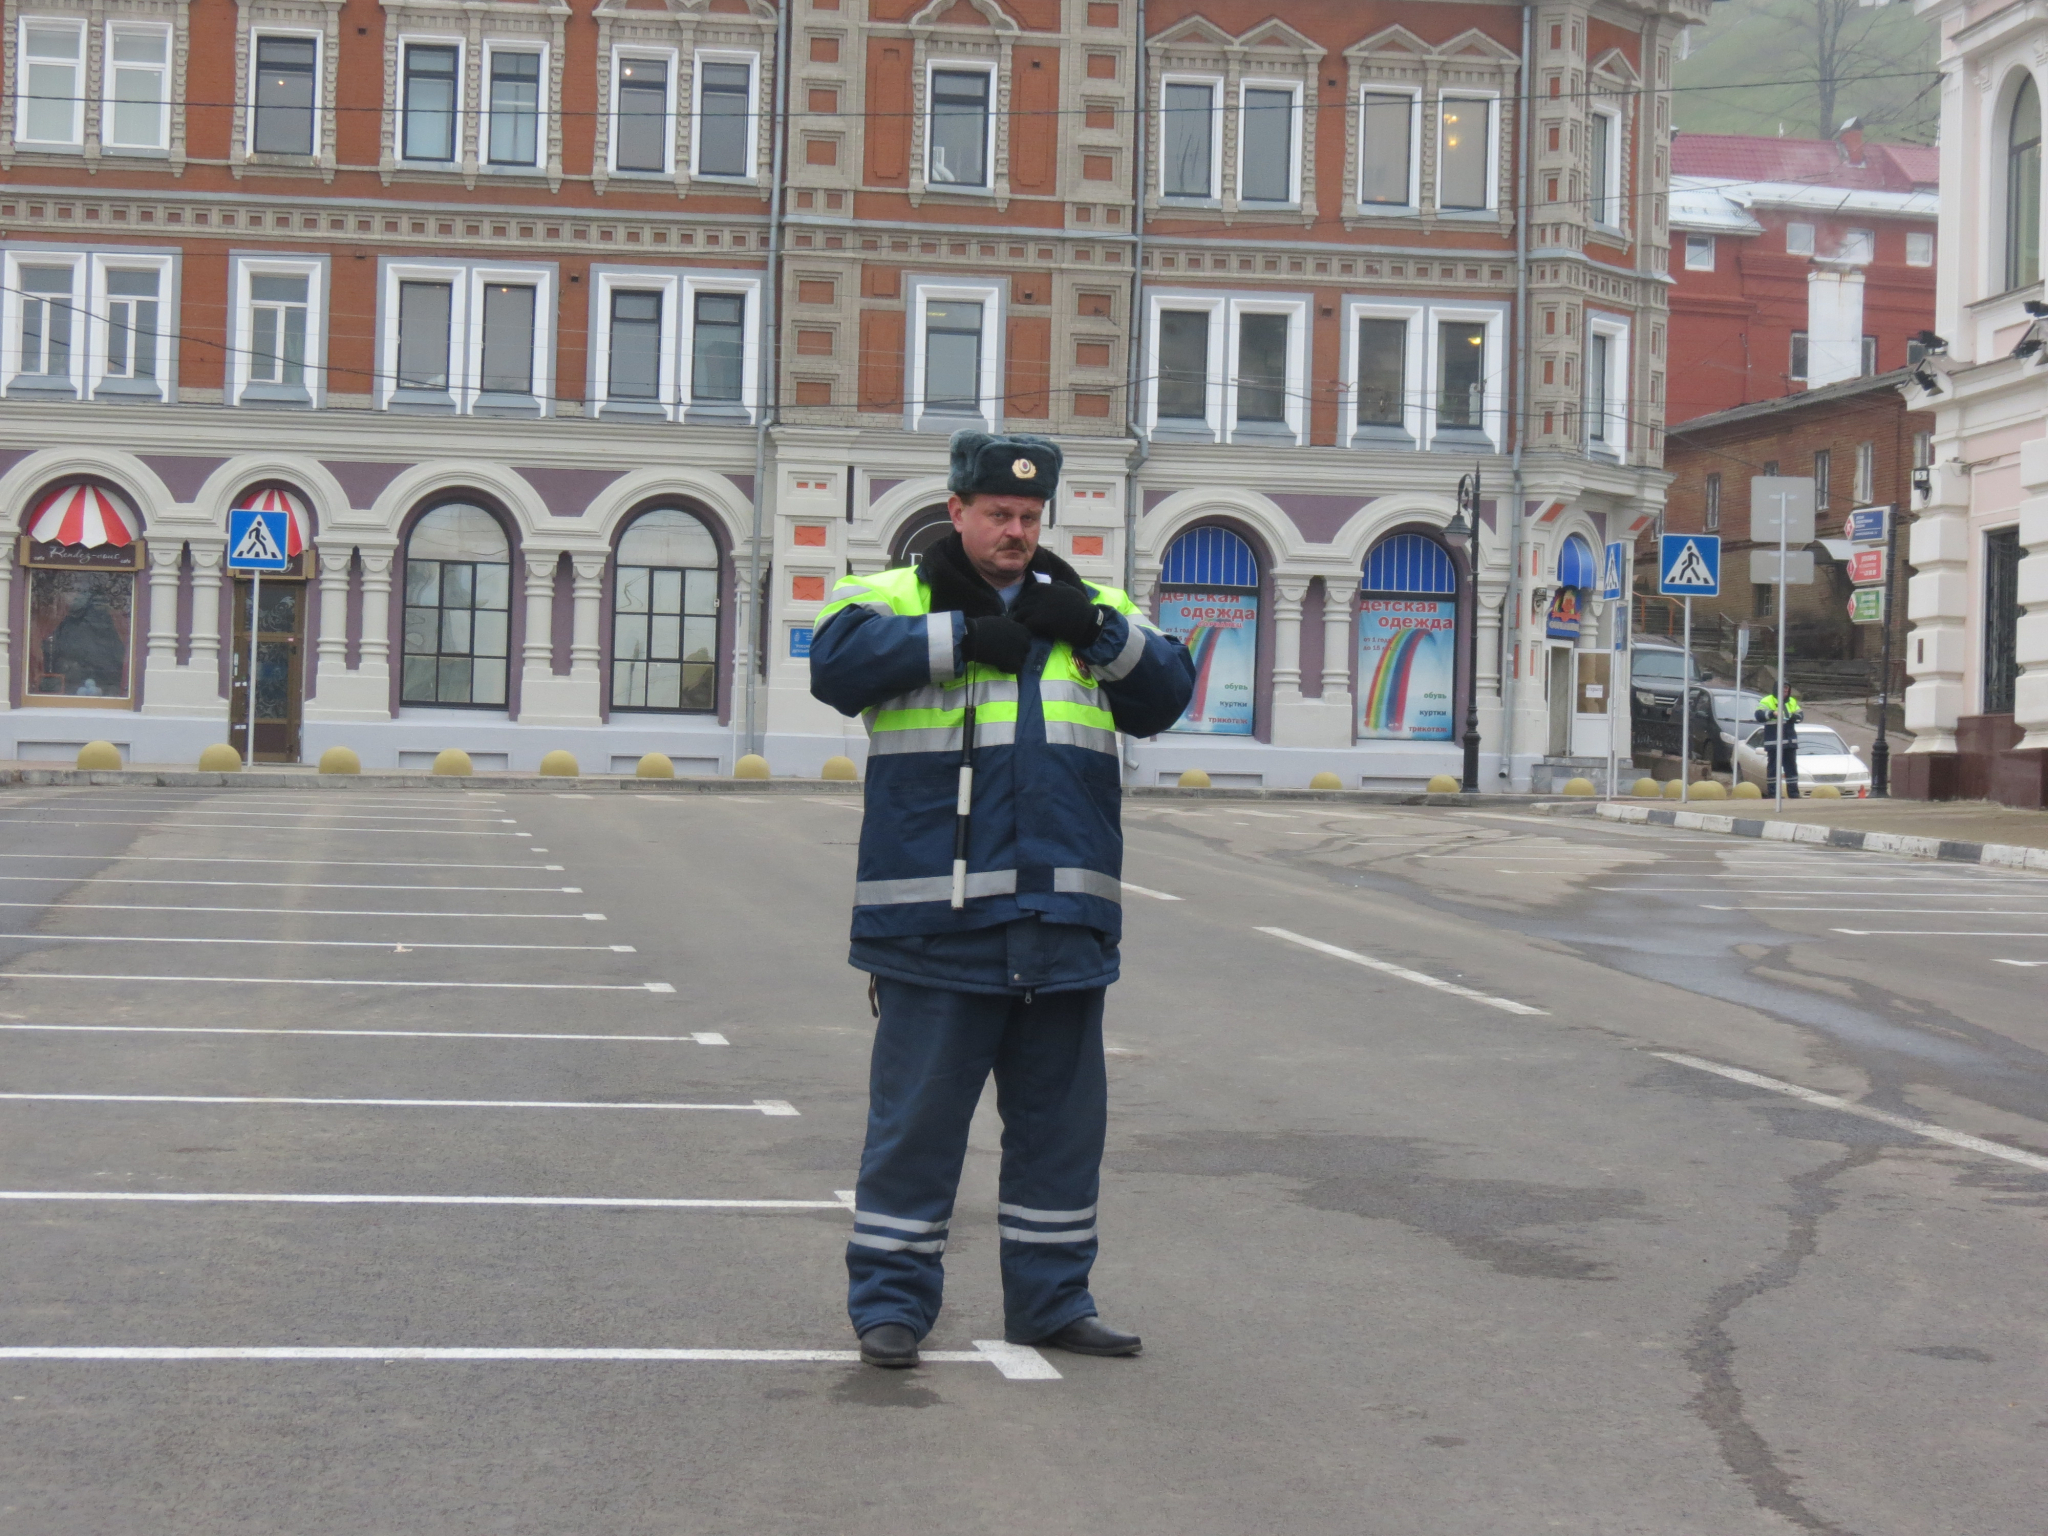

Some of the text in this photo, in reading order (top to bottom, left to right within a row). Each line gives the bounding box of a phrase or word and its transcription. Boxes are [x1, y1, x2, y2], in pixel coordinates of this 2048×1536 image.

[1918, 471, 1924, 480] 5
[1160, 593, 1240, 603] детская
[1359, 600, 1437, 613] детская
[1180, 607, 1255, 621] одежда
[1378, 616, 1453, 631] одежда
[1224, 683, 1248, 691] обувь
[1424, 691, 1447, 700] обувь
[1208, 717, 1248, 725] трикотаж
